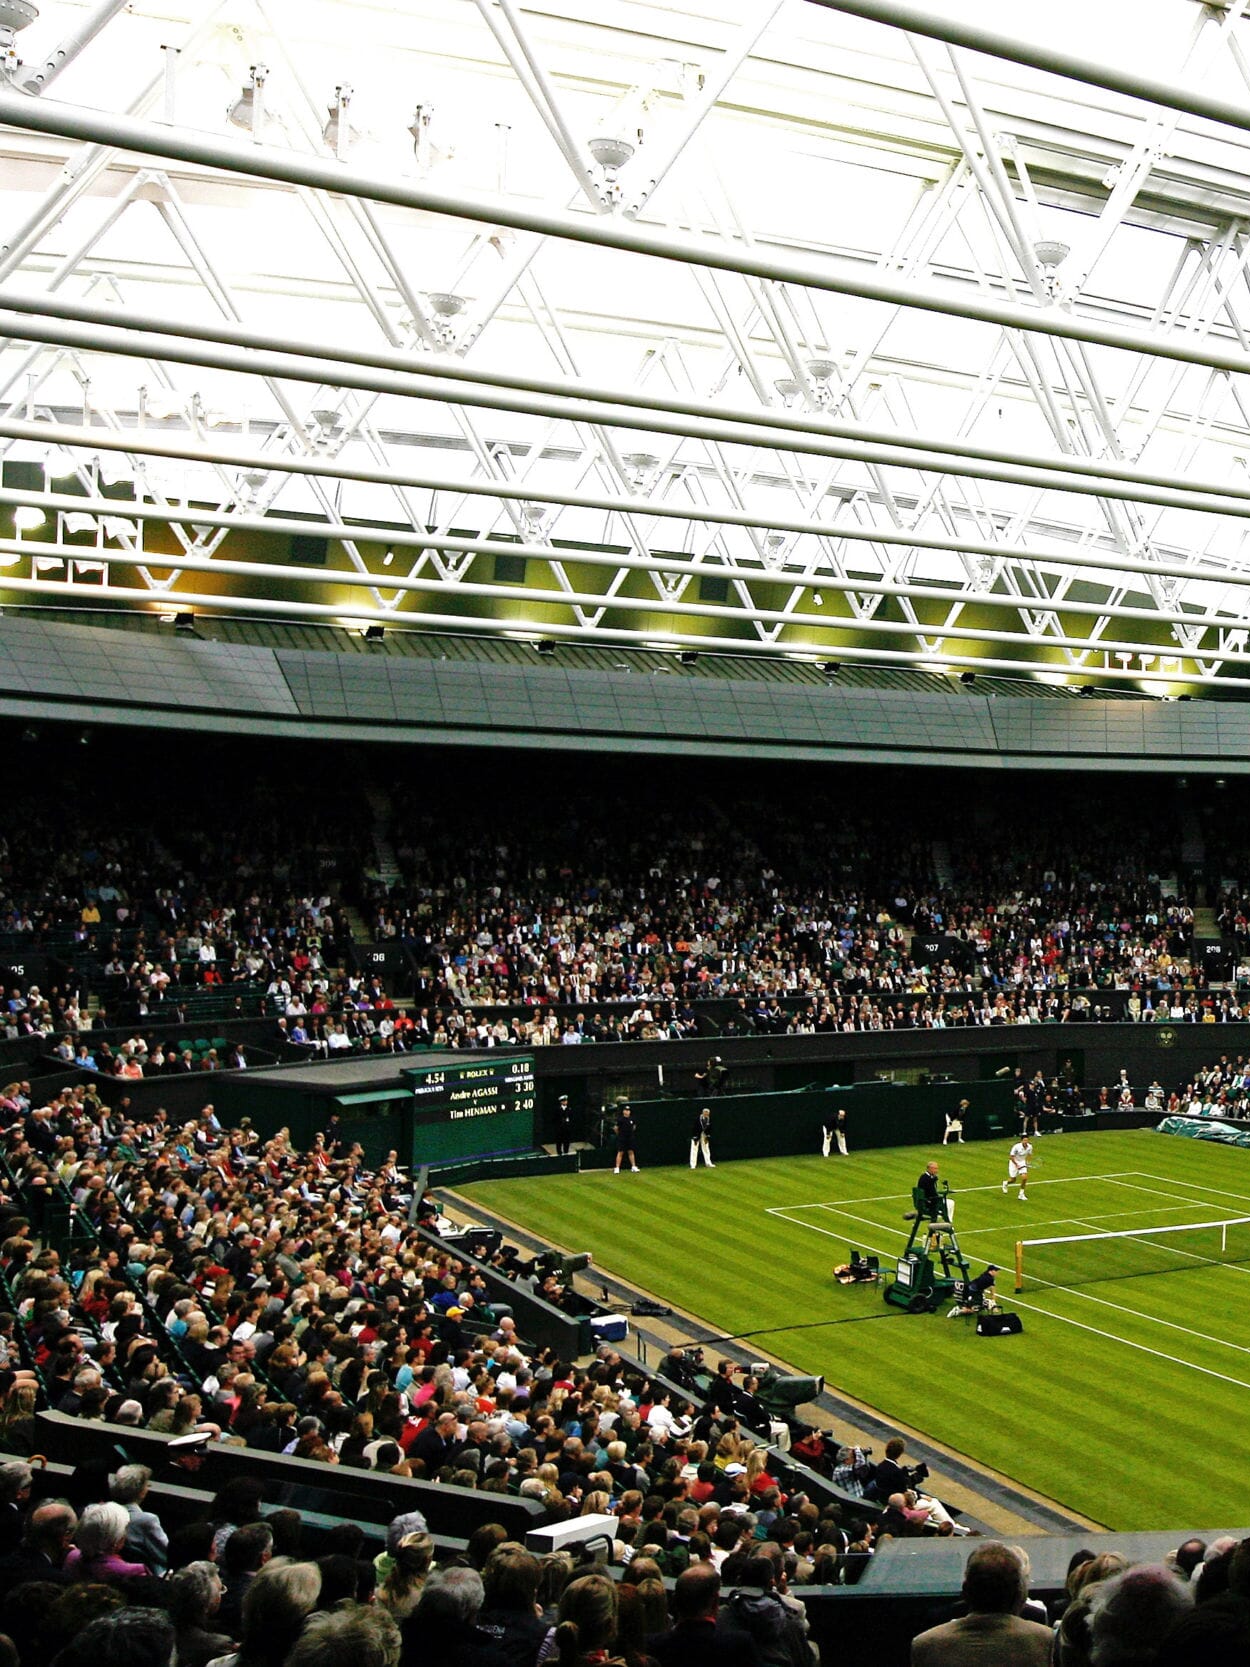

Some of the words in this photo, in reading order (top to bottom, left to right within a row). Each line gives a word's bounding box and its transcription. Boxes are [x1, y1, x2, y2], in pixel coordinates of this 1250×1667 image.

[425, 1072, 445, 1085] 4.54
[466, 1069, 488, 1079] ROLEX
[450, 1090, 471, 1100] Andre
[472, 1086, 498, 1097] AGASSI
[514, 1083, 521, 1093] 3
[523, 1081, 535, 1091] 30
[514, 1100, 521, 1111] 2
[522, 1098, 534, 1109] 40
[449, 1110, 464, 1120] Tim
[464, 1105, 498, 1118] HENMAN
